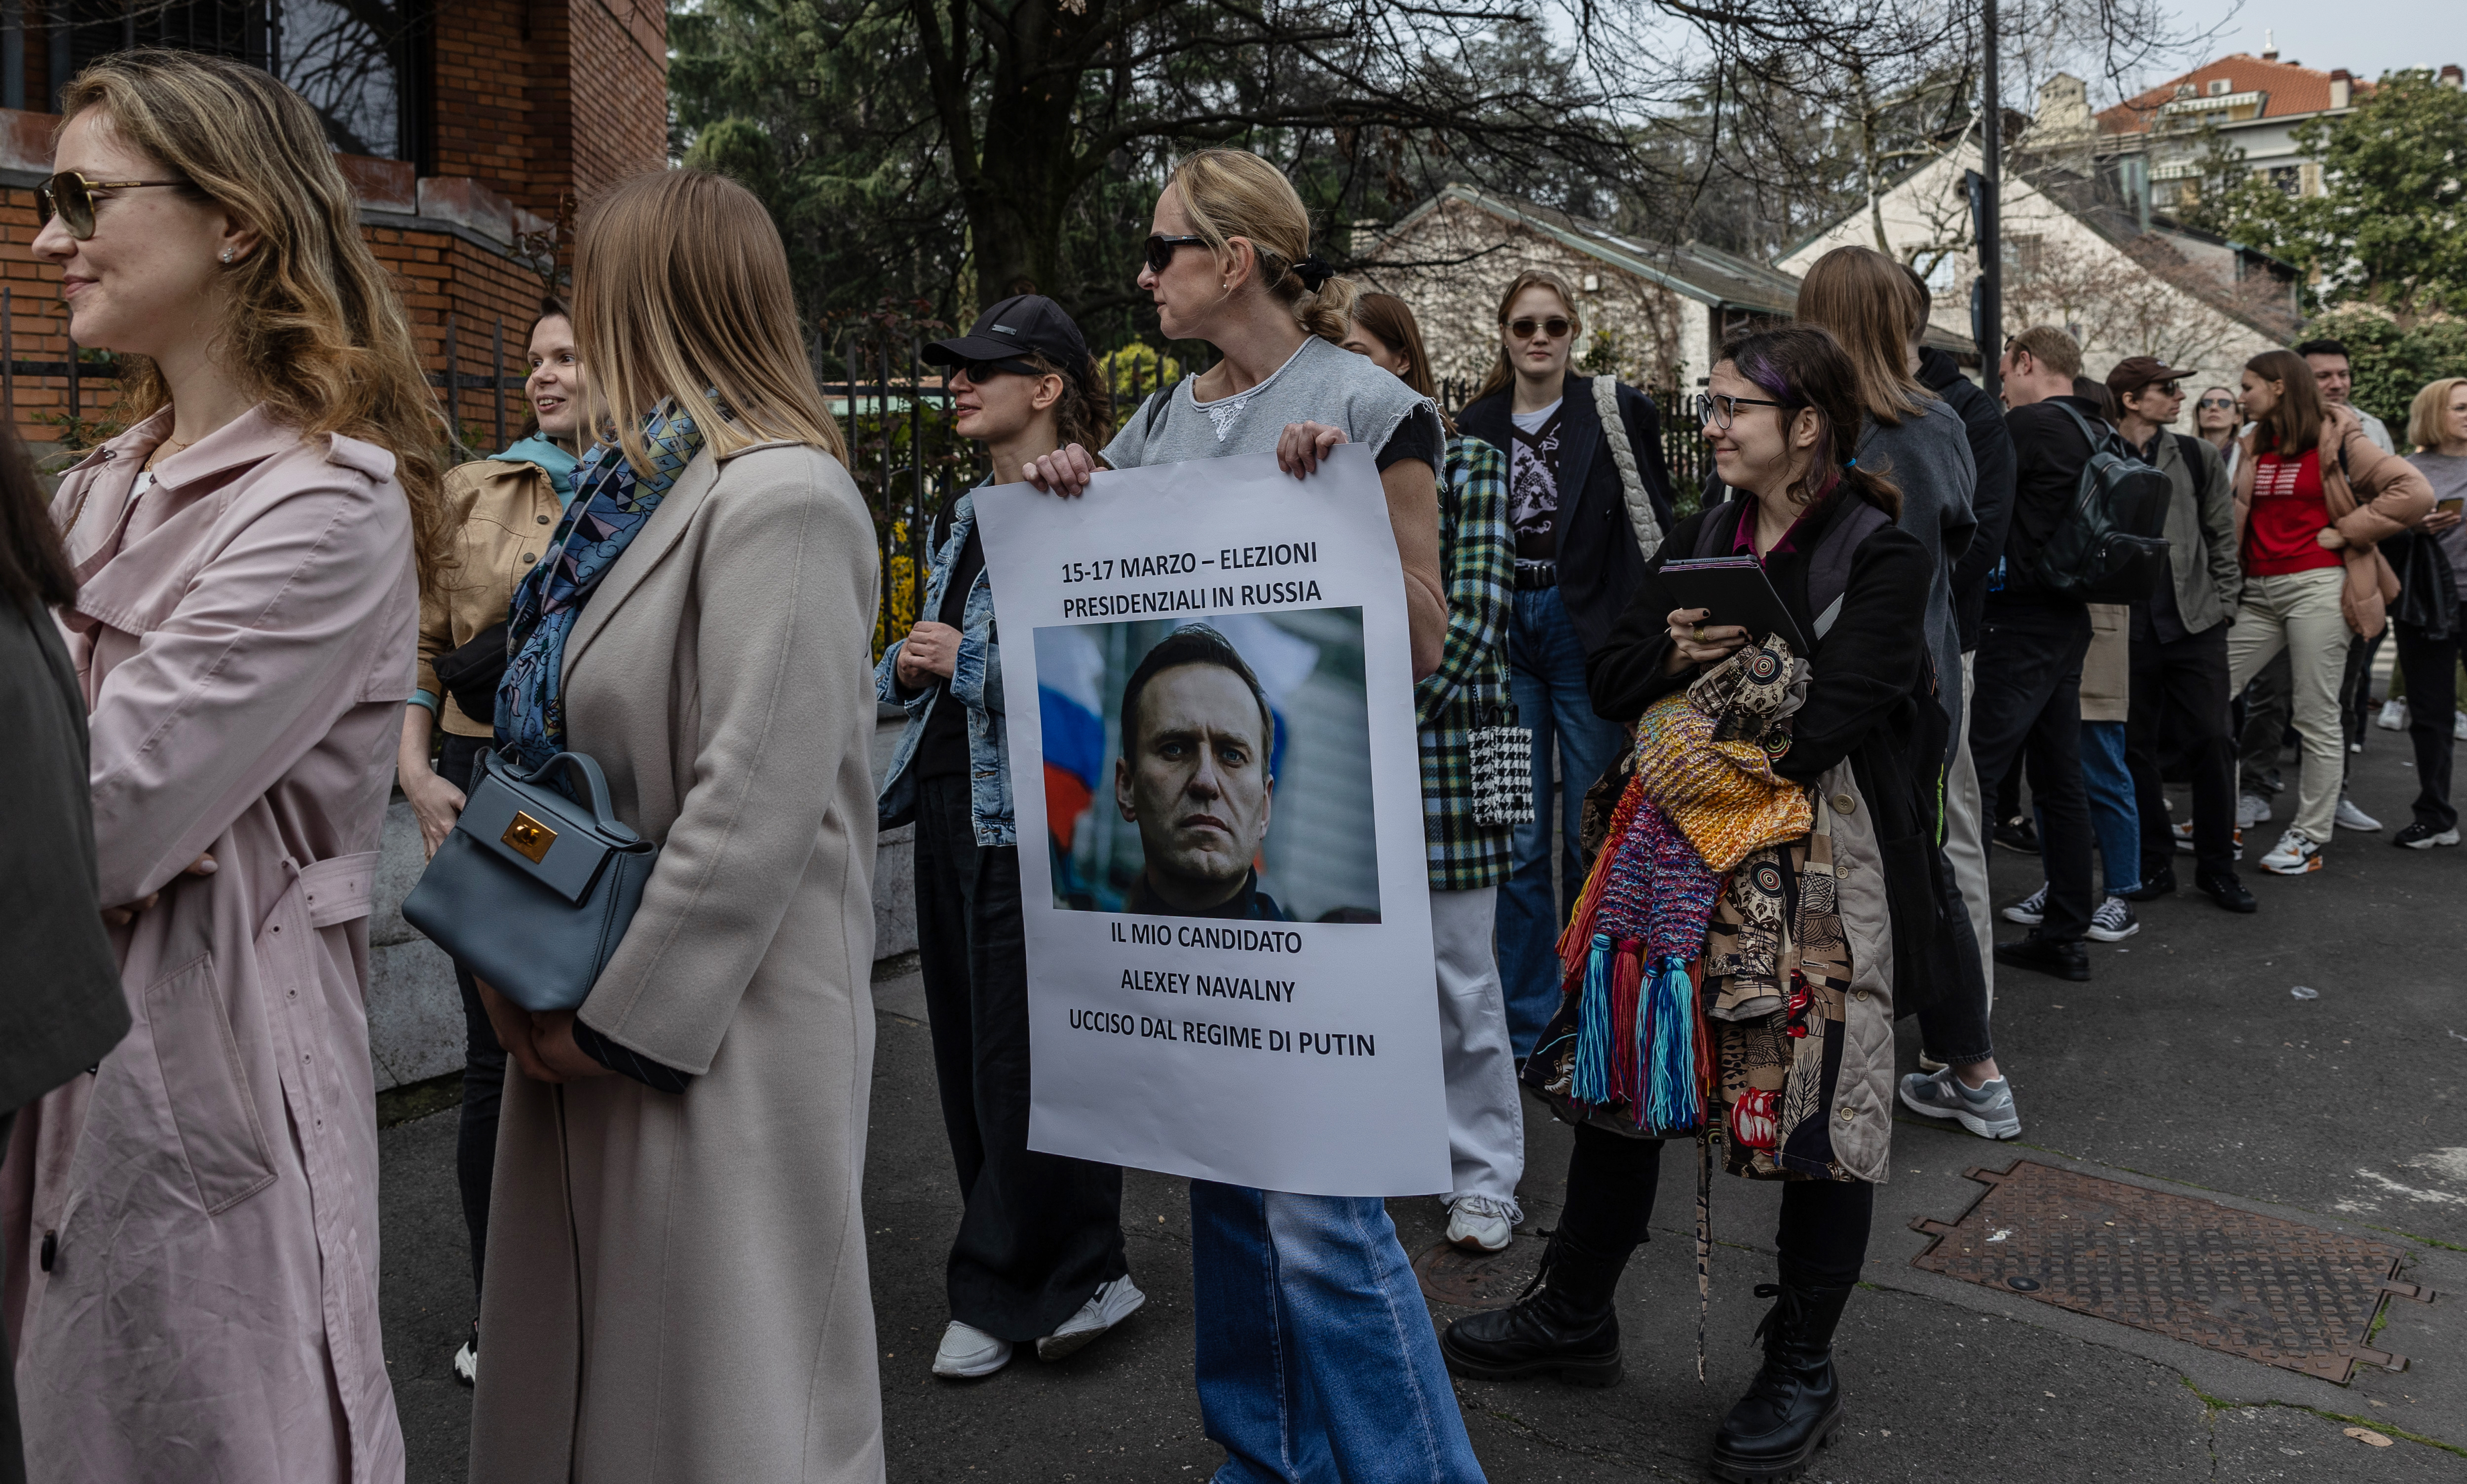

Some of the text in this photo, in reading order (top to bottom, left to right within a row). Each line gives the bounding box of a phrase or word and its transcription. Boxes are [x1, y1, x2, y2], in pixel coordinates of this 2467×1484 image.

[1062, 560, 1114, 583] 15-17
[1121, 553, 1196, 578] MARZO
[1221, 542, 1317, 570] ELEZIONI
[1063, 580, 1322, 618] PRESIDENZIALI IN RUSSIA
[1111, 922, 1302, 954] IL MIO CANDIDATO
[1121, 969, 1295, 1003] ALEXEY NAVALNY
[1070, 1008, 1375, 1056] UCCISO DAL REGIME DI PUTIN
[1940, 1081, 1956, 1097] N
